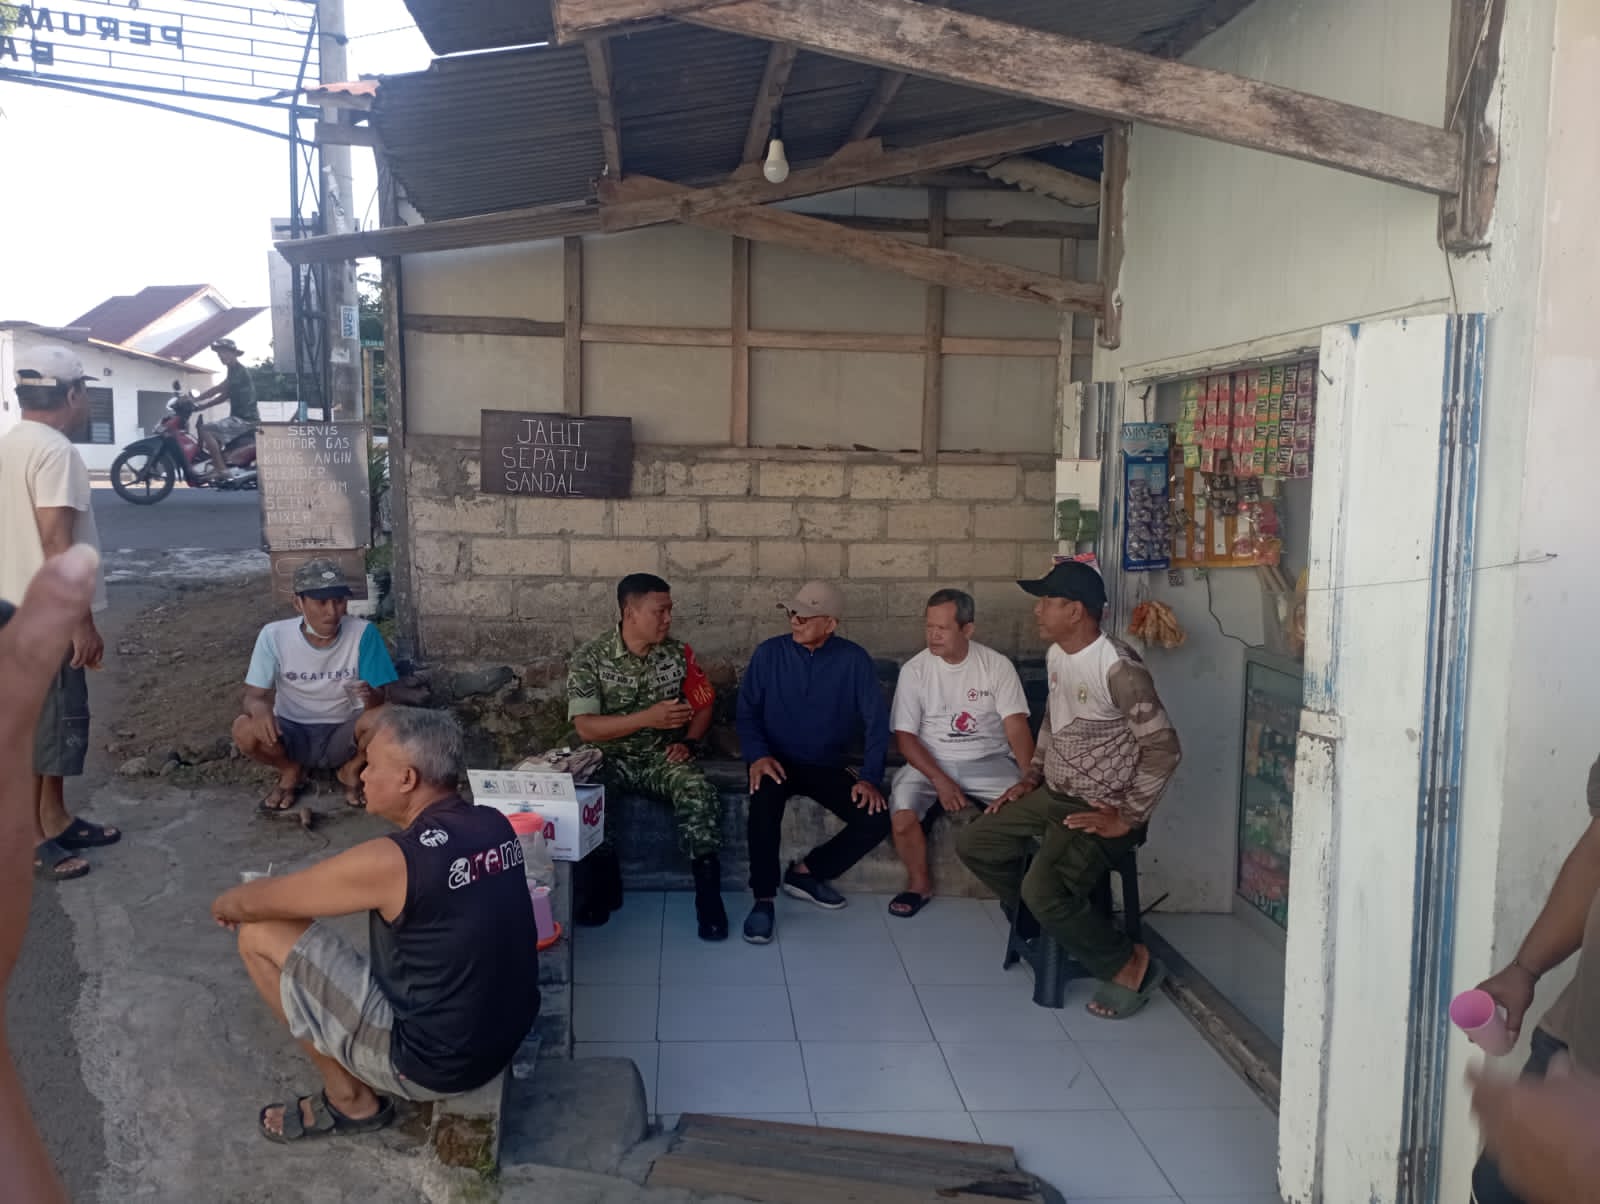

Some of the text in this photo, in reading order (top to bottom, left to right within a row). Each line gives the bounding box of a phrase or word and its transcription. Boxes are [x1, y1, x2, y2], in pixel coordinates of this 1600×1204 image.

[288, 425, 338, 436] SERVIS
[517, 419, 584, 447] JAHIT
[326, 437, 350, 449] GAS
[314, 451, 352, 465] ANGIN
[501, 446, 587, 472] SEPATU
[504, 472, 583, 494] SANDAL
